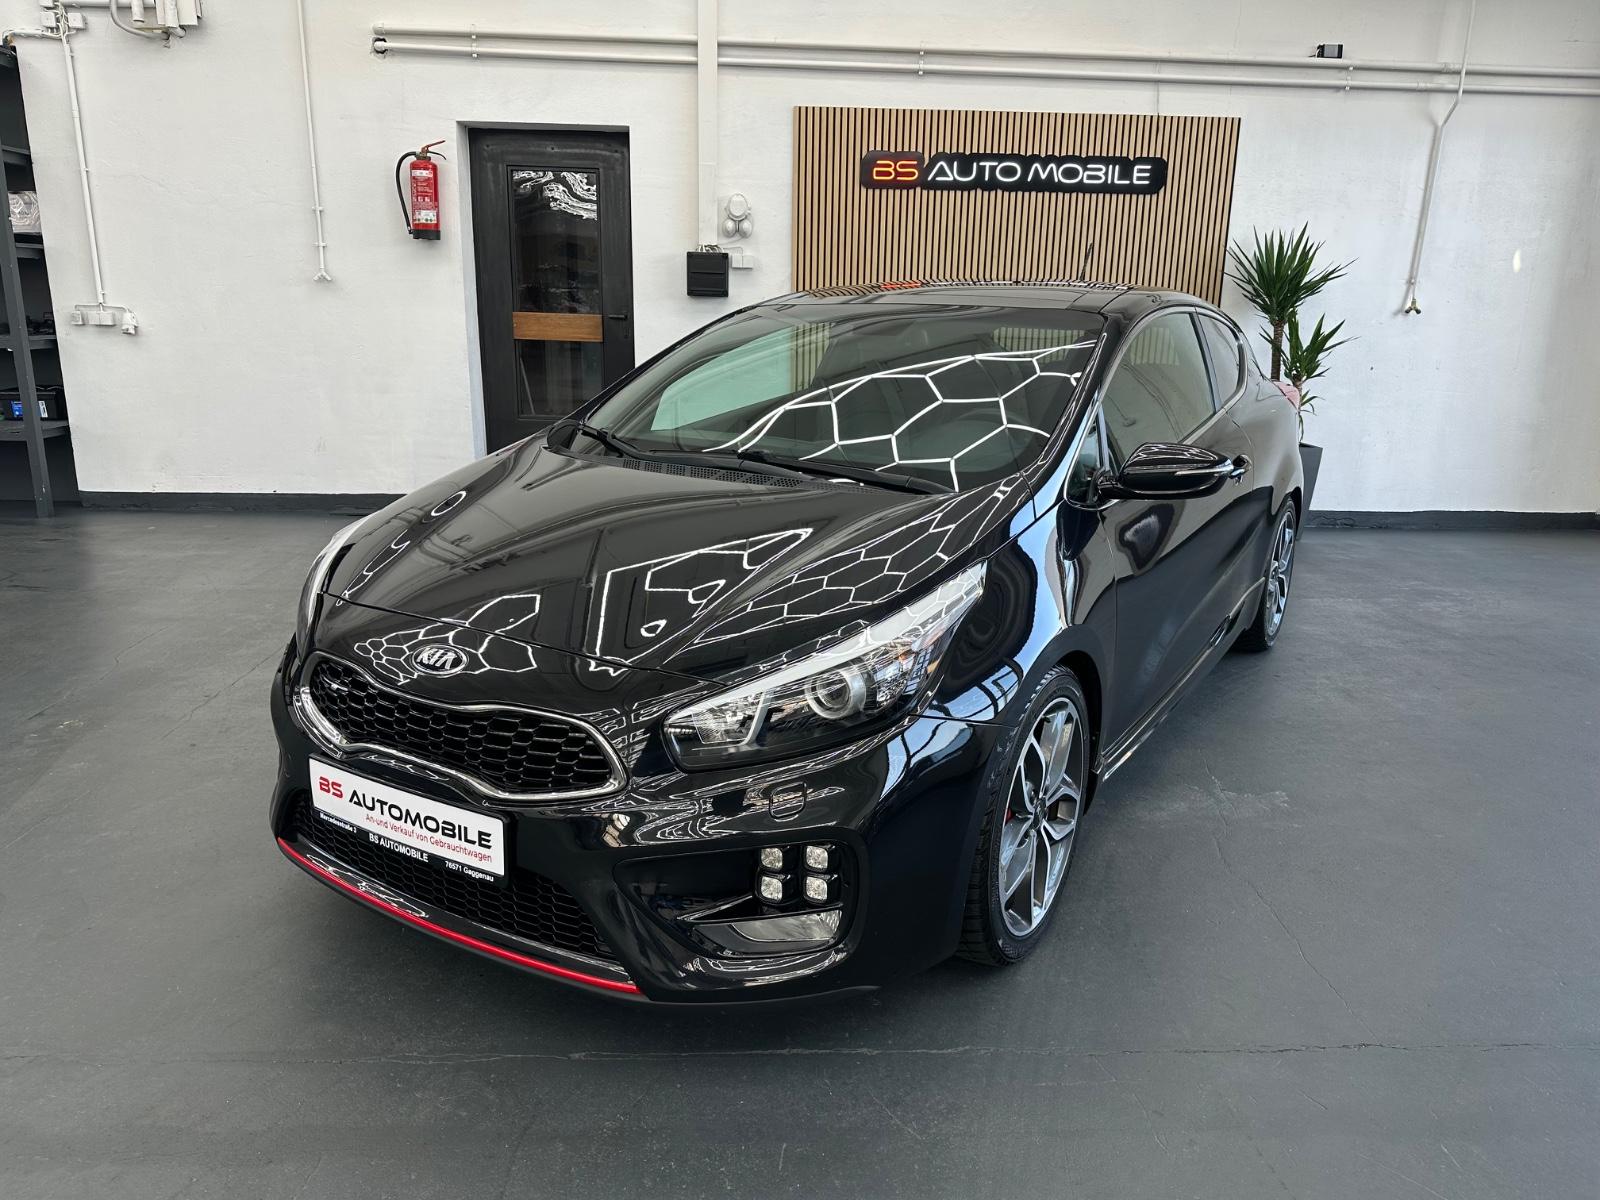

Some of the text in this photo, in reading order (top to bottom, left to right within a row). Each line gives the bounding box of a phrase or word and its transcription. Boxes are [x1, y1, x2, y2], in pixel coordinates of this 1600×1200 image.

[872, 160, 919, 181] BS
[416, 647, 458, 670] KIA
[318, 776, 493, 850] BS AUTOMOBILE
[365, 813, 493, 863] An-und Verkauf von Gebrauchtwagen
[369, 833, 429, 863] BS AUTOMOBILE
[463, 866, 495, 882] Gaggenau
